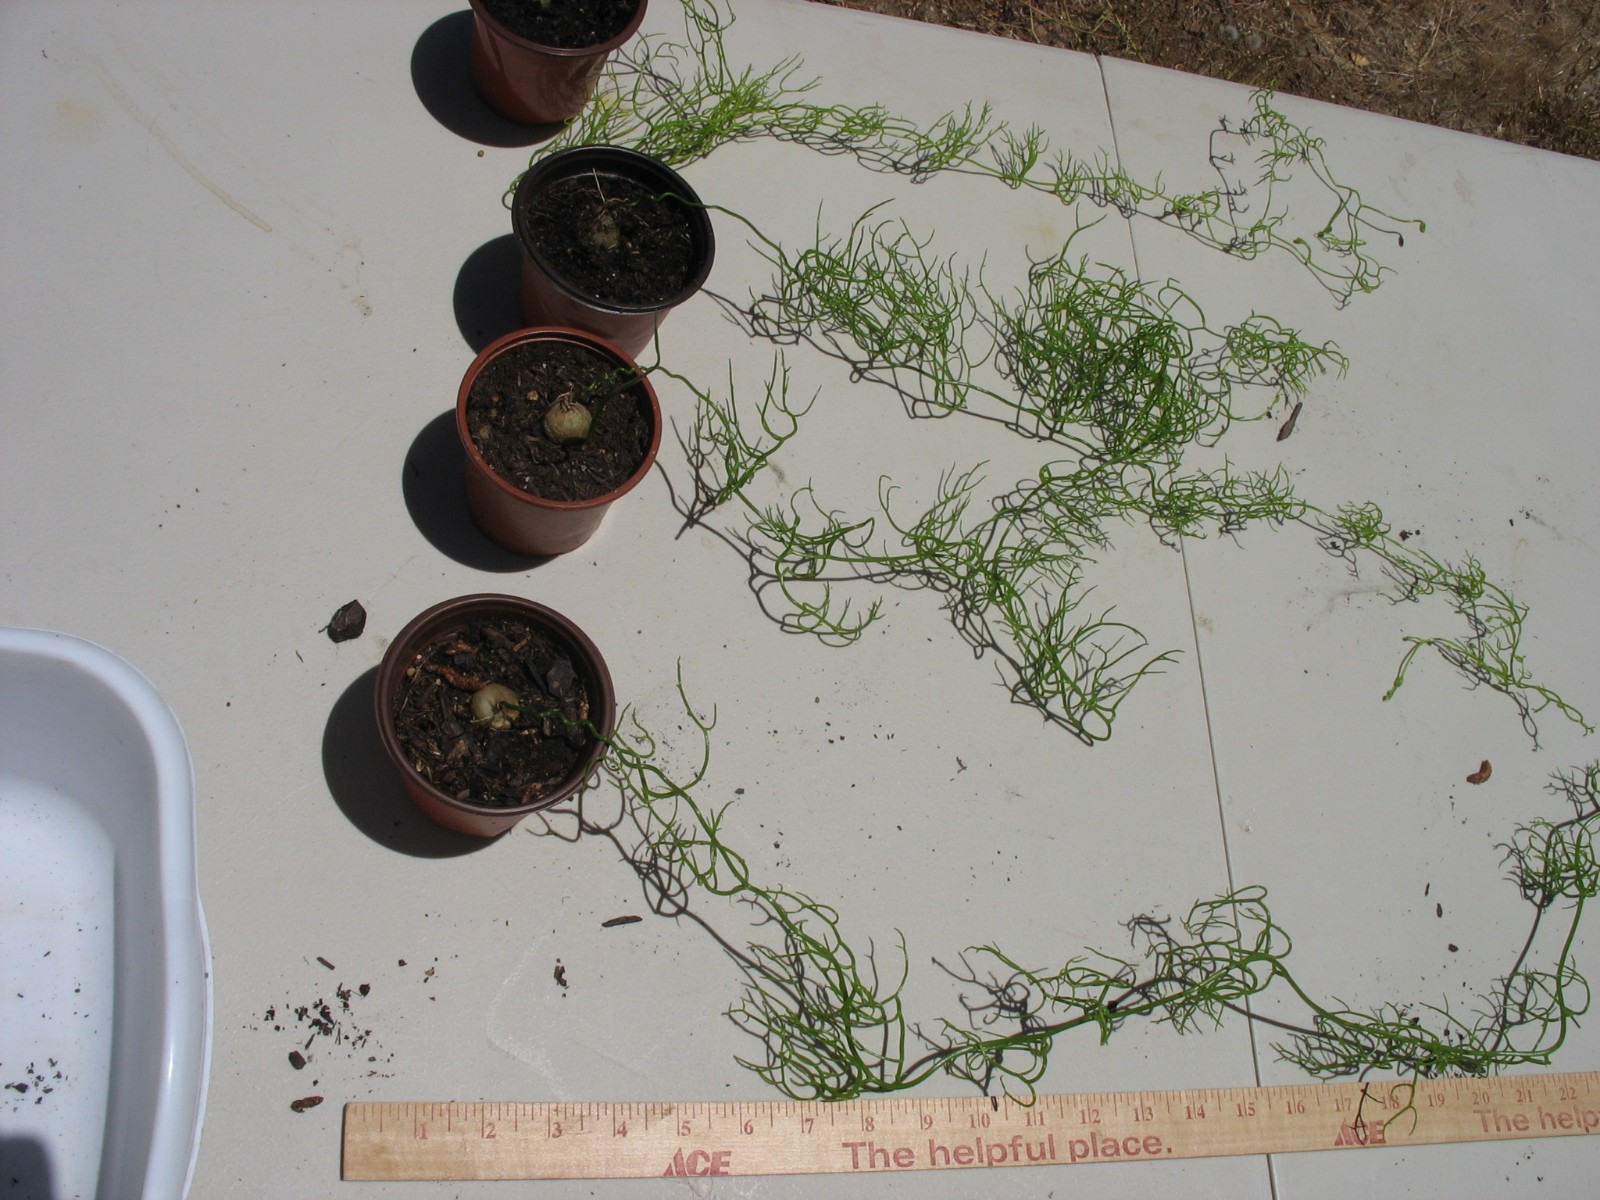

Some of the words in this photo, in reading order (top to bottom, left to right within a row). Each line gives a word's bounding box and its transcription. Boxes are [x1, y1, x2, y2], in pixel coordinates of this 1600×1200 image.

[419, 1122, 428, 1139] 1
[486, 1122, 496, 1139] 2
[552, 1121, 562, 1138] 3
[617, 1121, 627, 1137] 4
[681, 1120, 691, 1136] 5
[744, 1119, 754, 1135] 6
[805, 1118, 814, 1134] 7
[865, 1116, 875, 1132] 8
[923, 1115, 933, 1130] 9
[970, 1113, 990, 1128] 10
[1025, 1110, 1046, 1127] 11
[1080, 1108, 1101, 1124] 12
[1134, 1106, 1154, 1122] 13
[1186, 1103, 1206, 1119] 14
[1236, 1102, 1256, 1117] 15
[1287, 1100, 1305, 1115] 16
[1335, 1098, 1351, 1112] 17
[1382, 1096, 1400, 1110] 18
[1428, 1094, 1445, 1107] 19
[1472, 1092, 1490, 1105] 20
[1516, 1090, 1534, 1103] 21
[1560, 1087, 1577, 1101] 22
[1473, 1107, 1529, 1132] The
[1537, 1104, 1600, 1133] help
[1334, 1118, 1386, 1146] ACE
[663, 1147, 732, 1176] ACE
[842, 1141, 915, 1169] The
[928, 1133, 1056, 1166] helpful
[1068, 1131, 1173, 1162] place.
